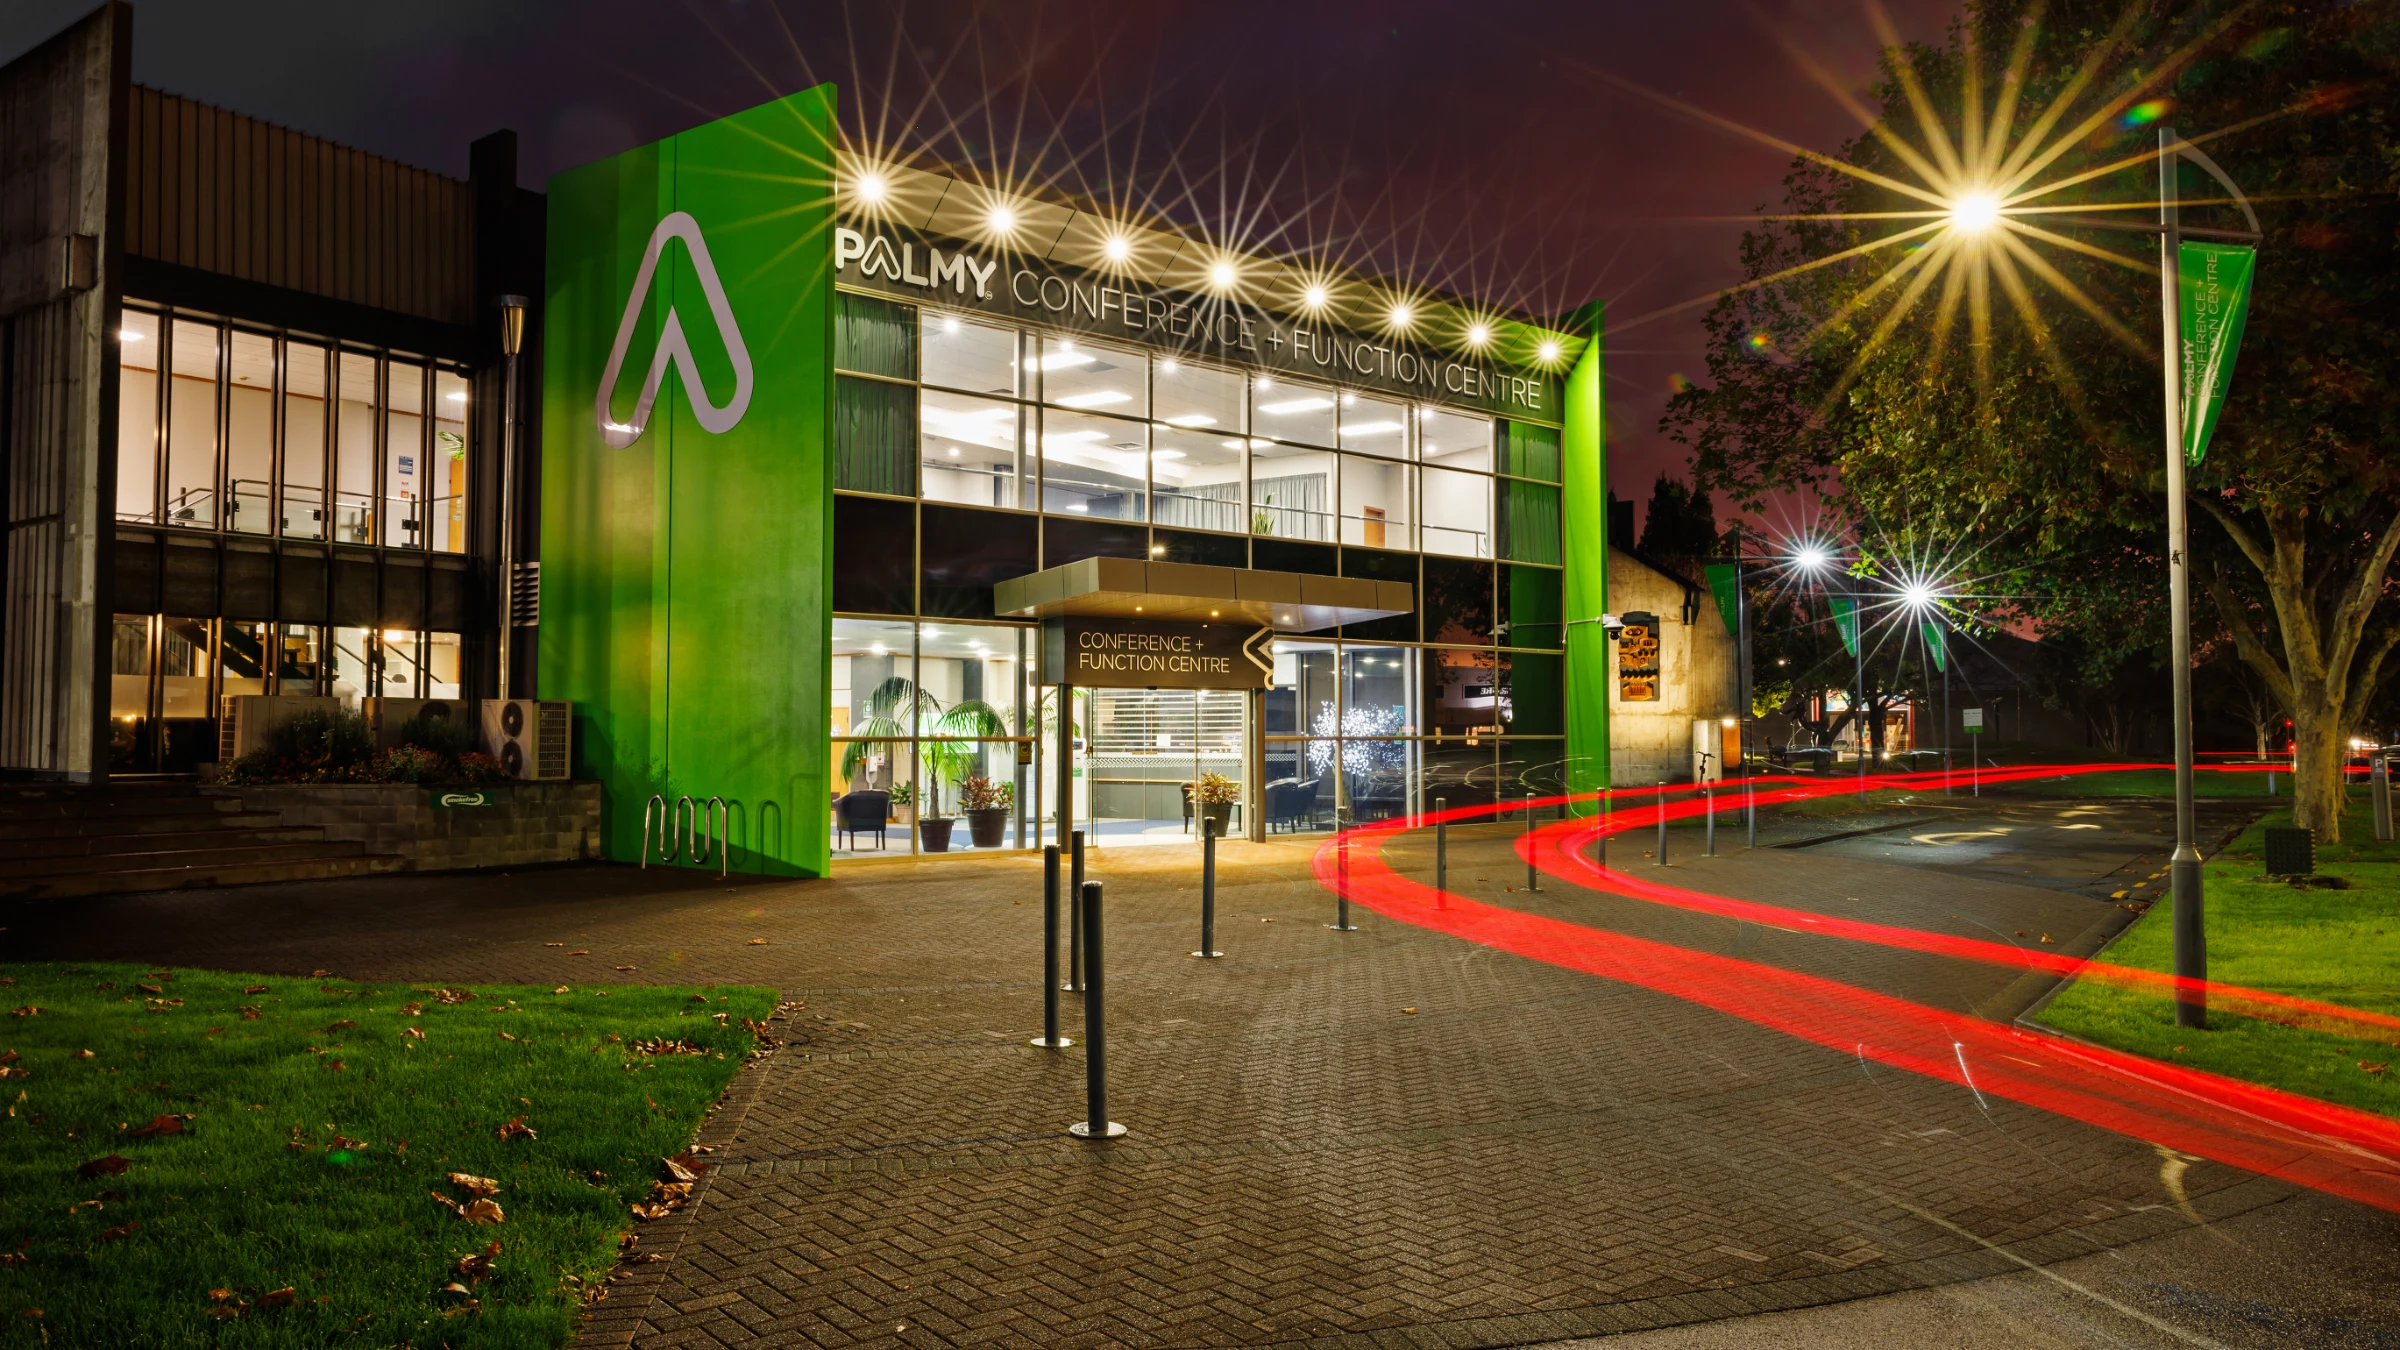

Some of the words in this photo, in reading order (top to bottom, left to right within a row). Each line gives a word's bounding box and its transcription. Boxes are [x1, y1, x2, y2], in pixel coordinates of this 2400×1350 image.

[2207, 252, 2219, 315] CENTRE
[834, 227, 997, 299] PALMY
[1012, 269, 1257, 351] CONFERENCE
[1267, 329, 1284, 351] +
[1293, 329, 1437, 388] FUNCTION
[1445, 363, 1542, 410] CENTRE
[2196, 291, 2208, 398] CONFERENCE
[2184, 339, 2195, 398] PALMY
[1079, 631, 1191, 652] CONFERENCE
[1195, 639, 1204, 651] +
[1079, 652, 1165, 671] FUNCTION
[1168, 655, 1230, 673] CENTRE
[2375, 758, 2383, 767] P
